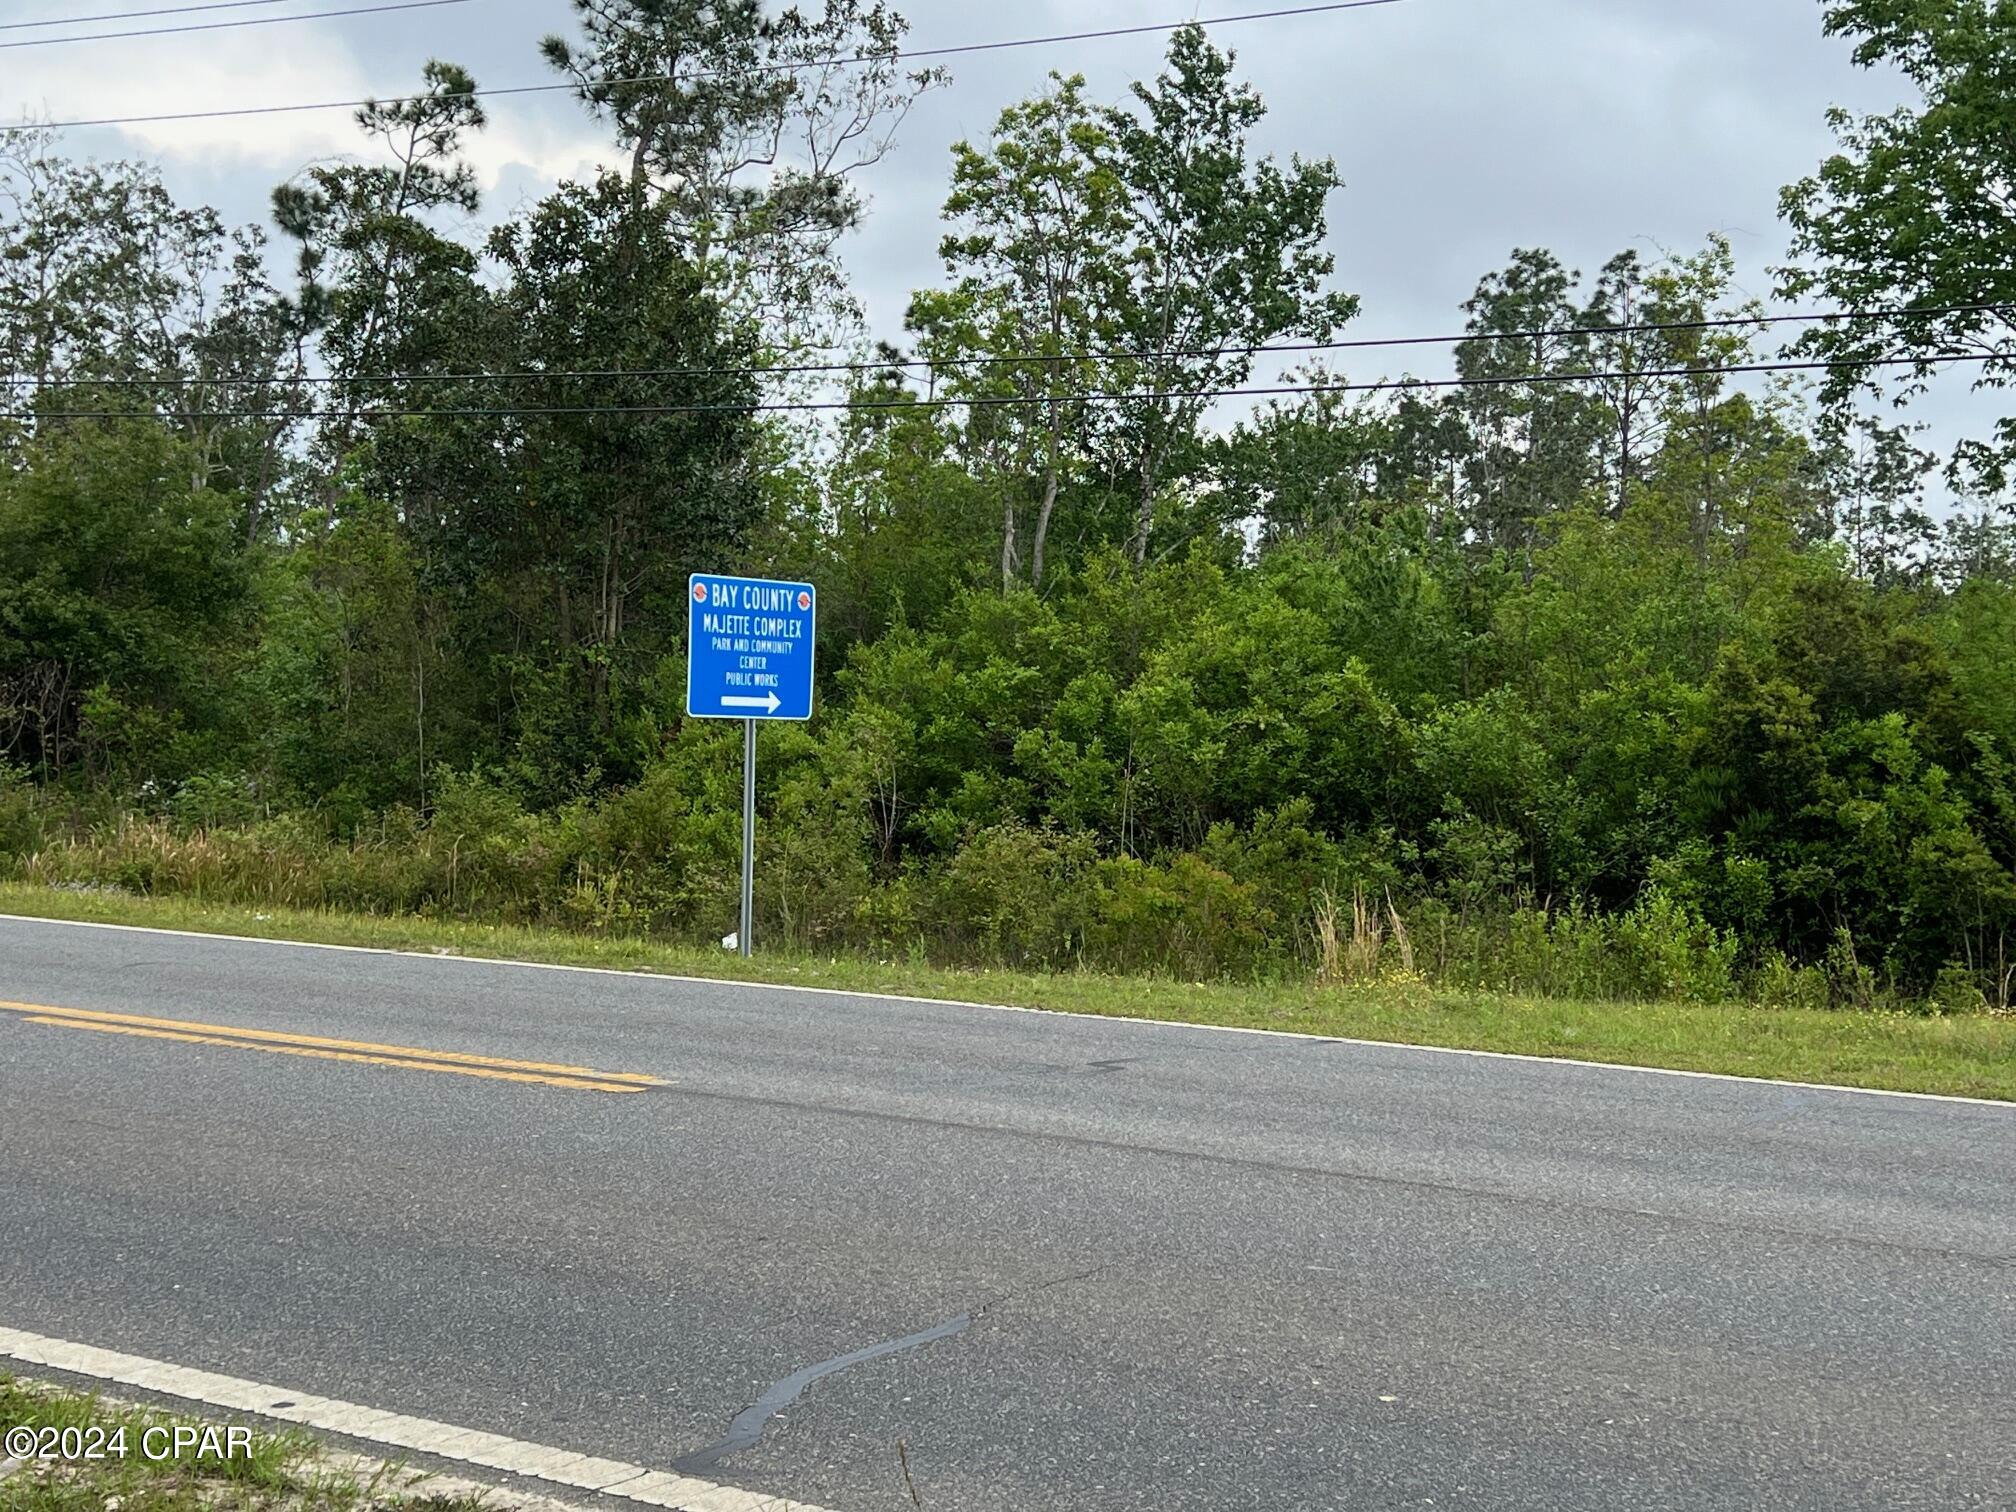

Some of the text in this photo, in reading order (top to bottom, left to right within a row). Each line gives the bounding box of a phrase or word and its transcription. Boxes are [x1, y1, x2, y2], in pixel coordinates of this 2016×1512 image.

[712, 584, 794, 612] BAY COUNTY
[703, 613, 802, 638] MAJETTE COMPLEX
[712, 637, 793, 654] PARK AND COMMUNITY
[740, 656, 767, 669] CENTER
[726, 672, 778, 687] PUBLIC WORKS
